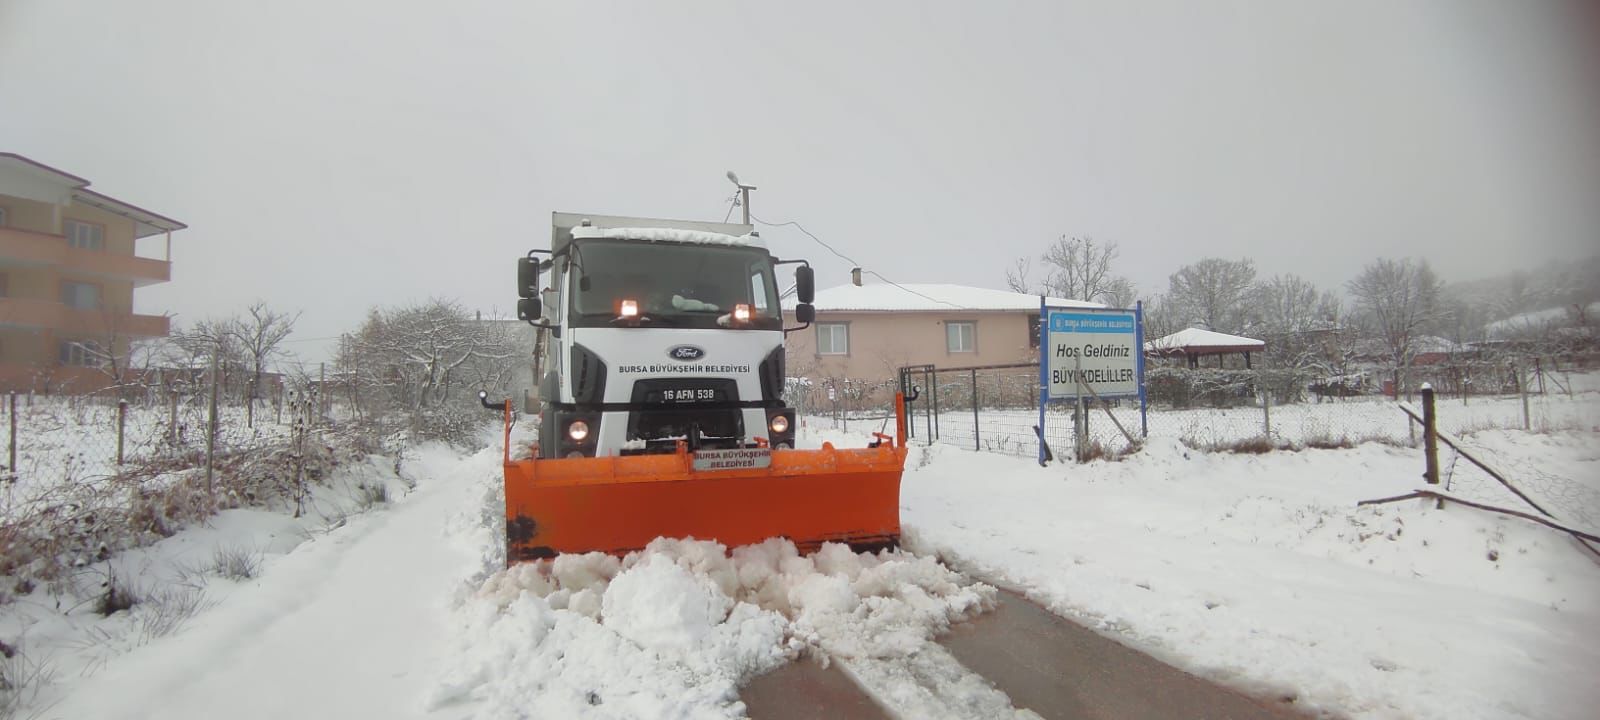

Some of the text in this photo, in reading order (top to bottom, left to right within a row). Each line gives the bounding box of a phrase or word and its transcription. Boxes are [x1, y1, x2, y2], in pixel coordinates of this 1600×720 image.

[675, 348, 698, 358] Ford
[1084, 343, 1130, 358] Geldiniz
[619, 363, 750, 374] BURSA BÜYÜKŞEHİR BELEDİYESİ
[663, 389, 714, 400] 16 AFN 538
